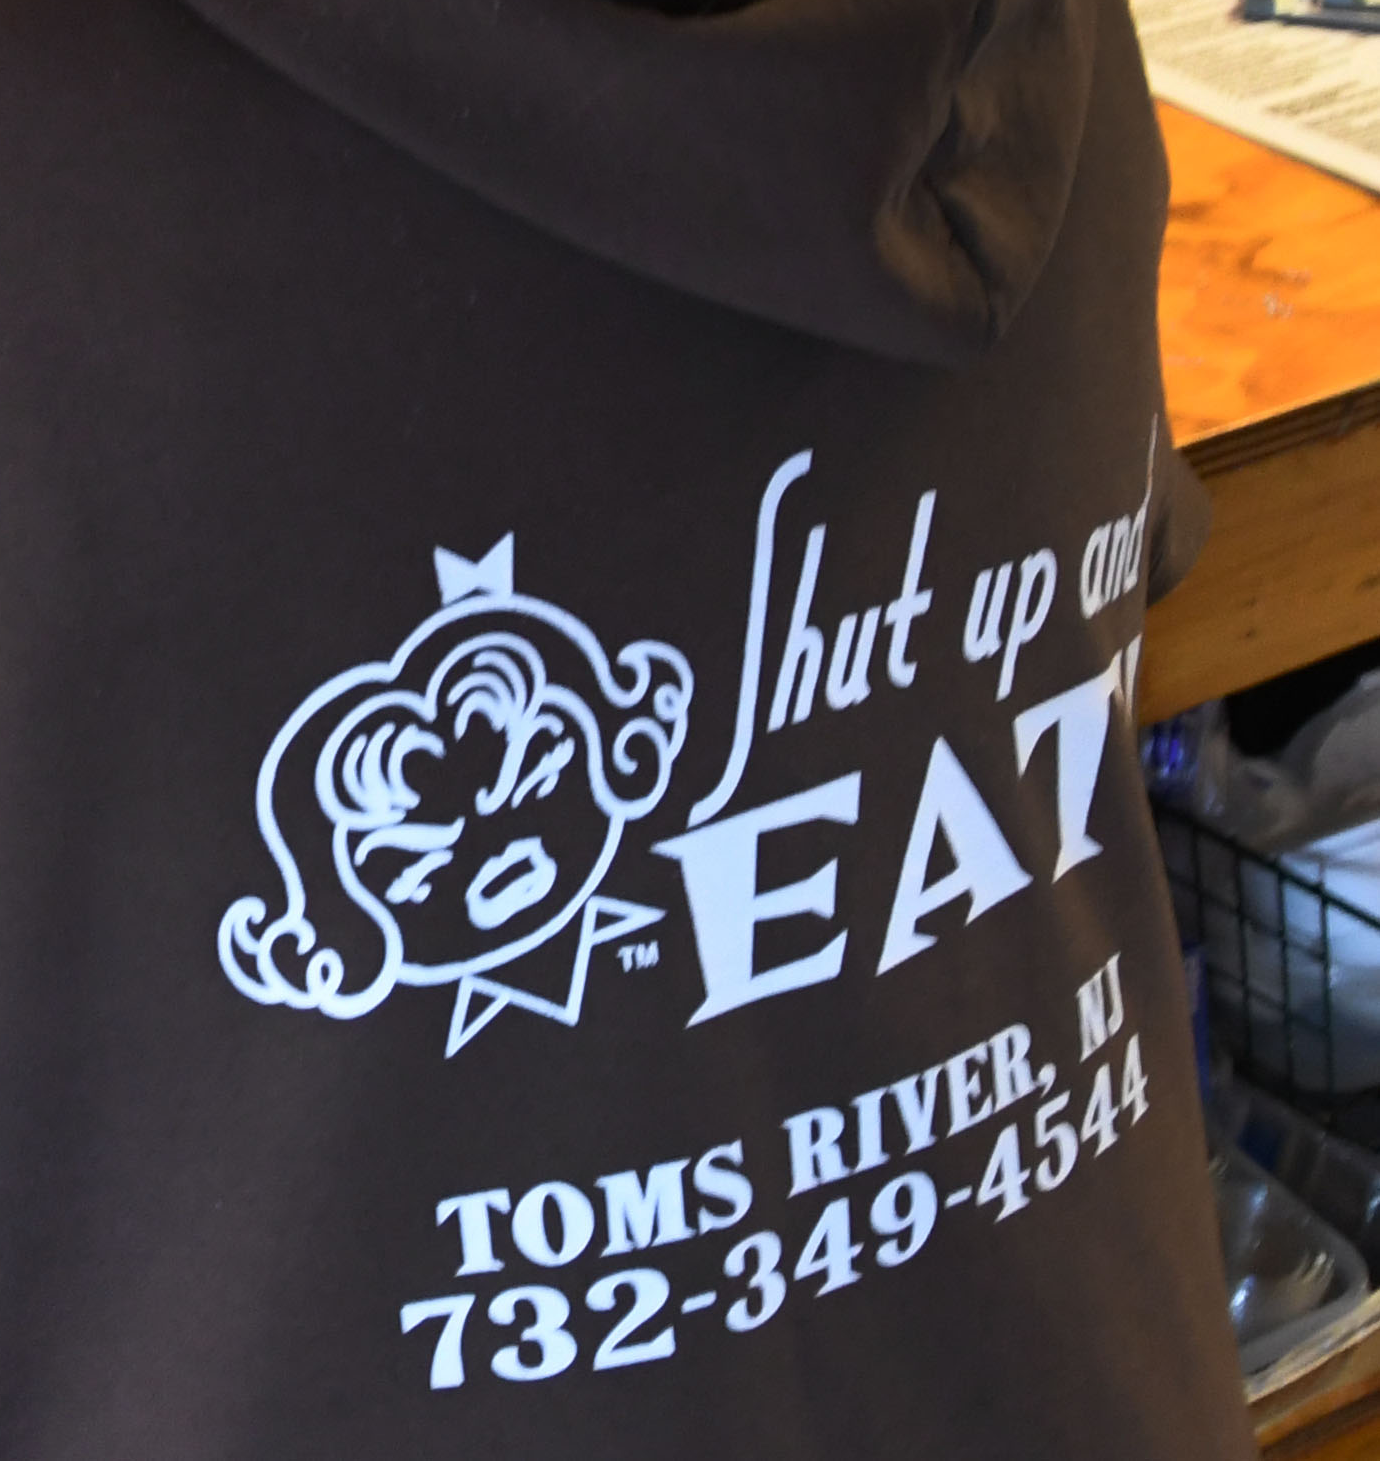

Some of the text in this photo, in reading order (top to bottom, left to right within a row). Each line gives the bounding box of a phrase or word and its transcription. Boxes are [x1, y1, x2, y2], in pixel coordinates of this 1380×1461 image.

[687, 412, 1158, 828] Shut up and
[435, 952, 1125, 1277] TOMS RIVER, NJ
[616, 940, 660, 973] TM
[399, 1033, 1150, 1390] 732-349-4544
